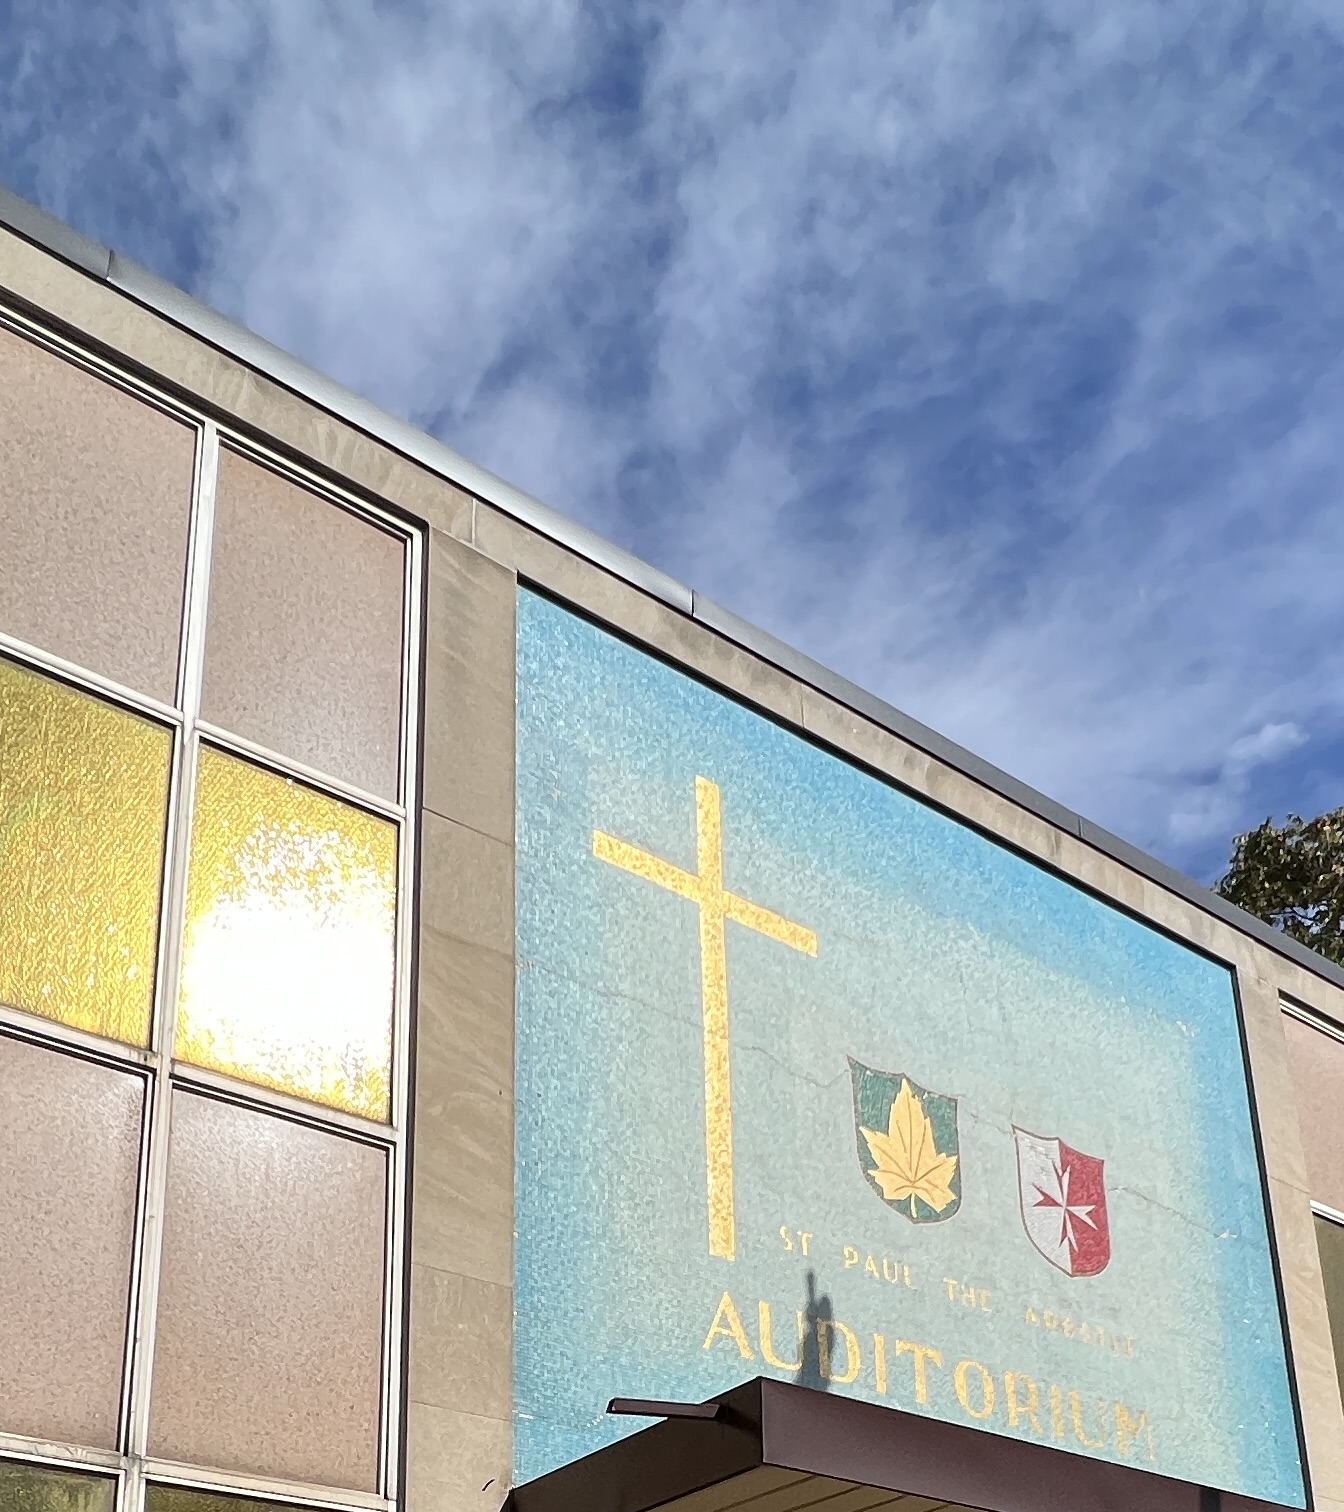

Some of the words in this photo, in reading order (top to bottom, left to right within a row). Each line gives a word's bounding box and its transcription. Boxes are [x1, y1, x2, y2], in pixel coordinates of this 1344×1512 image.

[778, 1225, 814, 1256] ST
[842, 1244, 919, 1291] PAUL
[942, 1276, 993, 1314] THE
[702, 1290, 1156, 1461] AUDITORIUM
